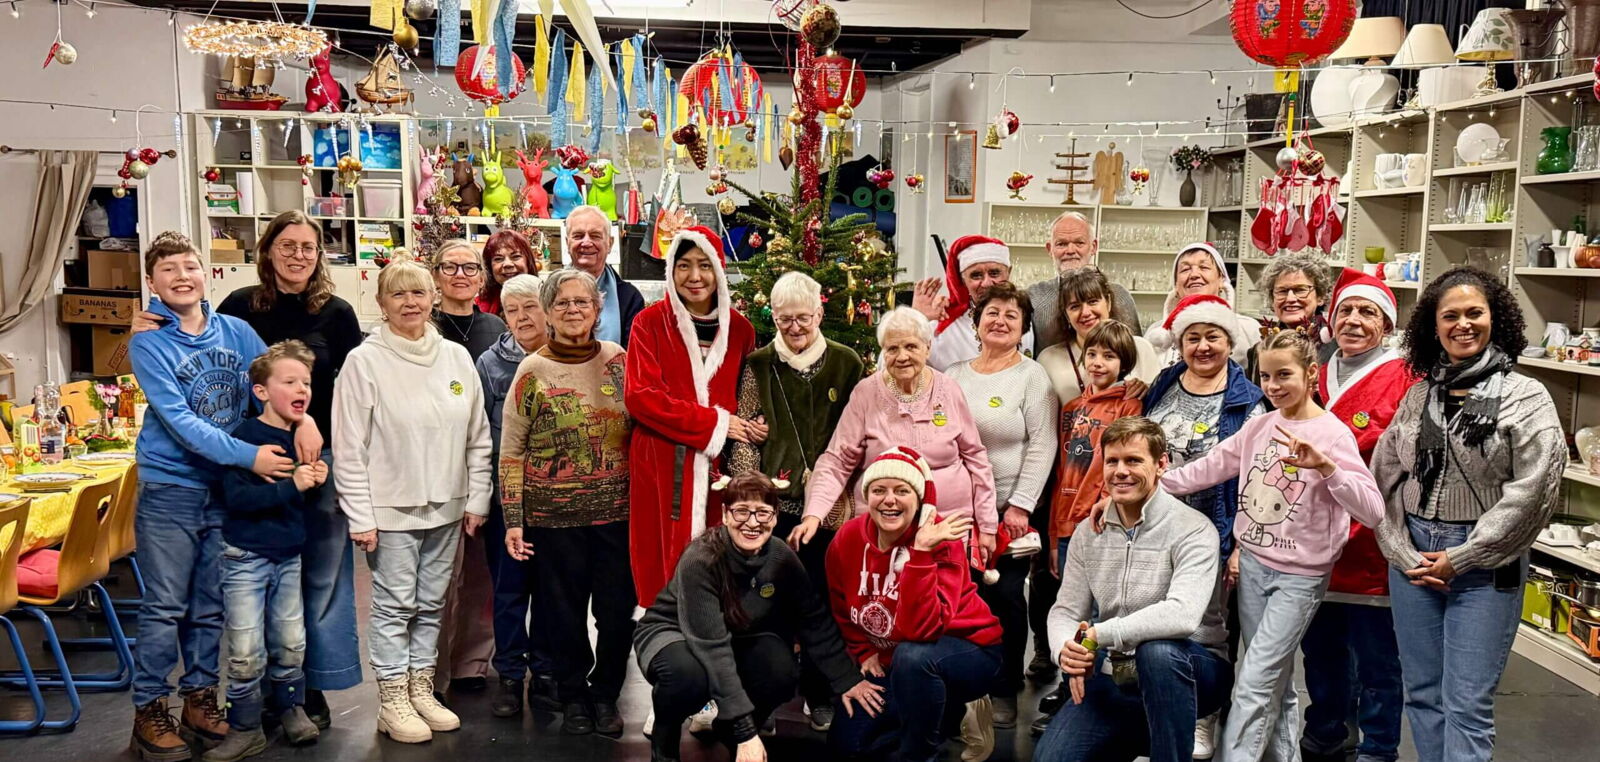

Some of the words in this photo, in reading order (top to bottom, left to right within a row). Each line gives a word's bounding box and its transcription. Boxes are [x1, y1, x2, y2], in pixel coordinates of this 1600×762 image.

[212, 267, 224, 279] M
[361, 270, 369, 281] K
[79, 298, 117, 308] BANANAS
[175, 355, 205, 386] NEW
[204, 372, 236, 386] COLLEGE
